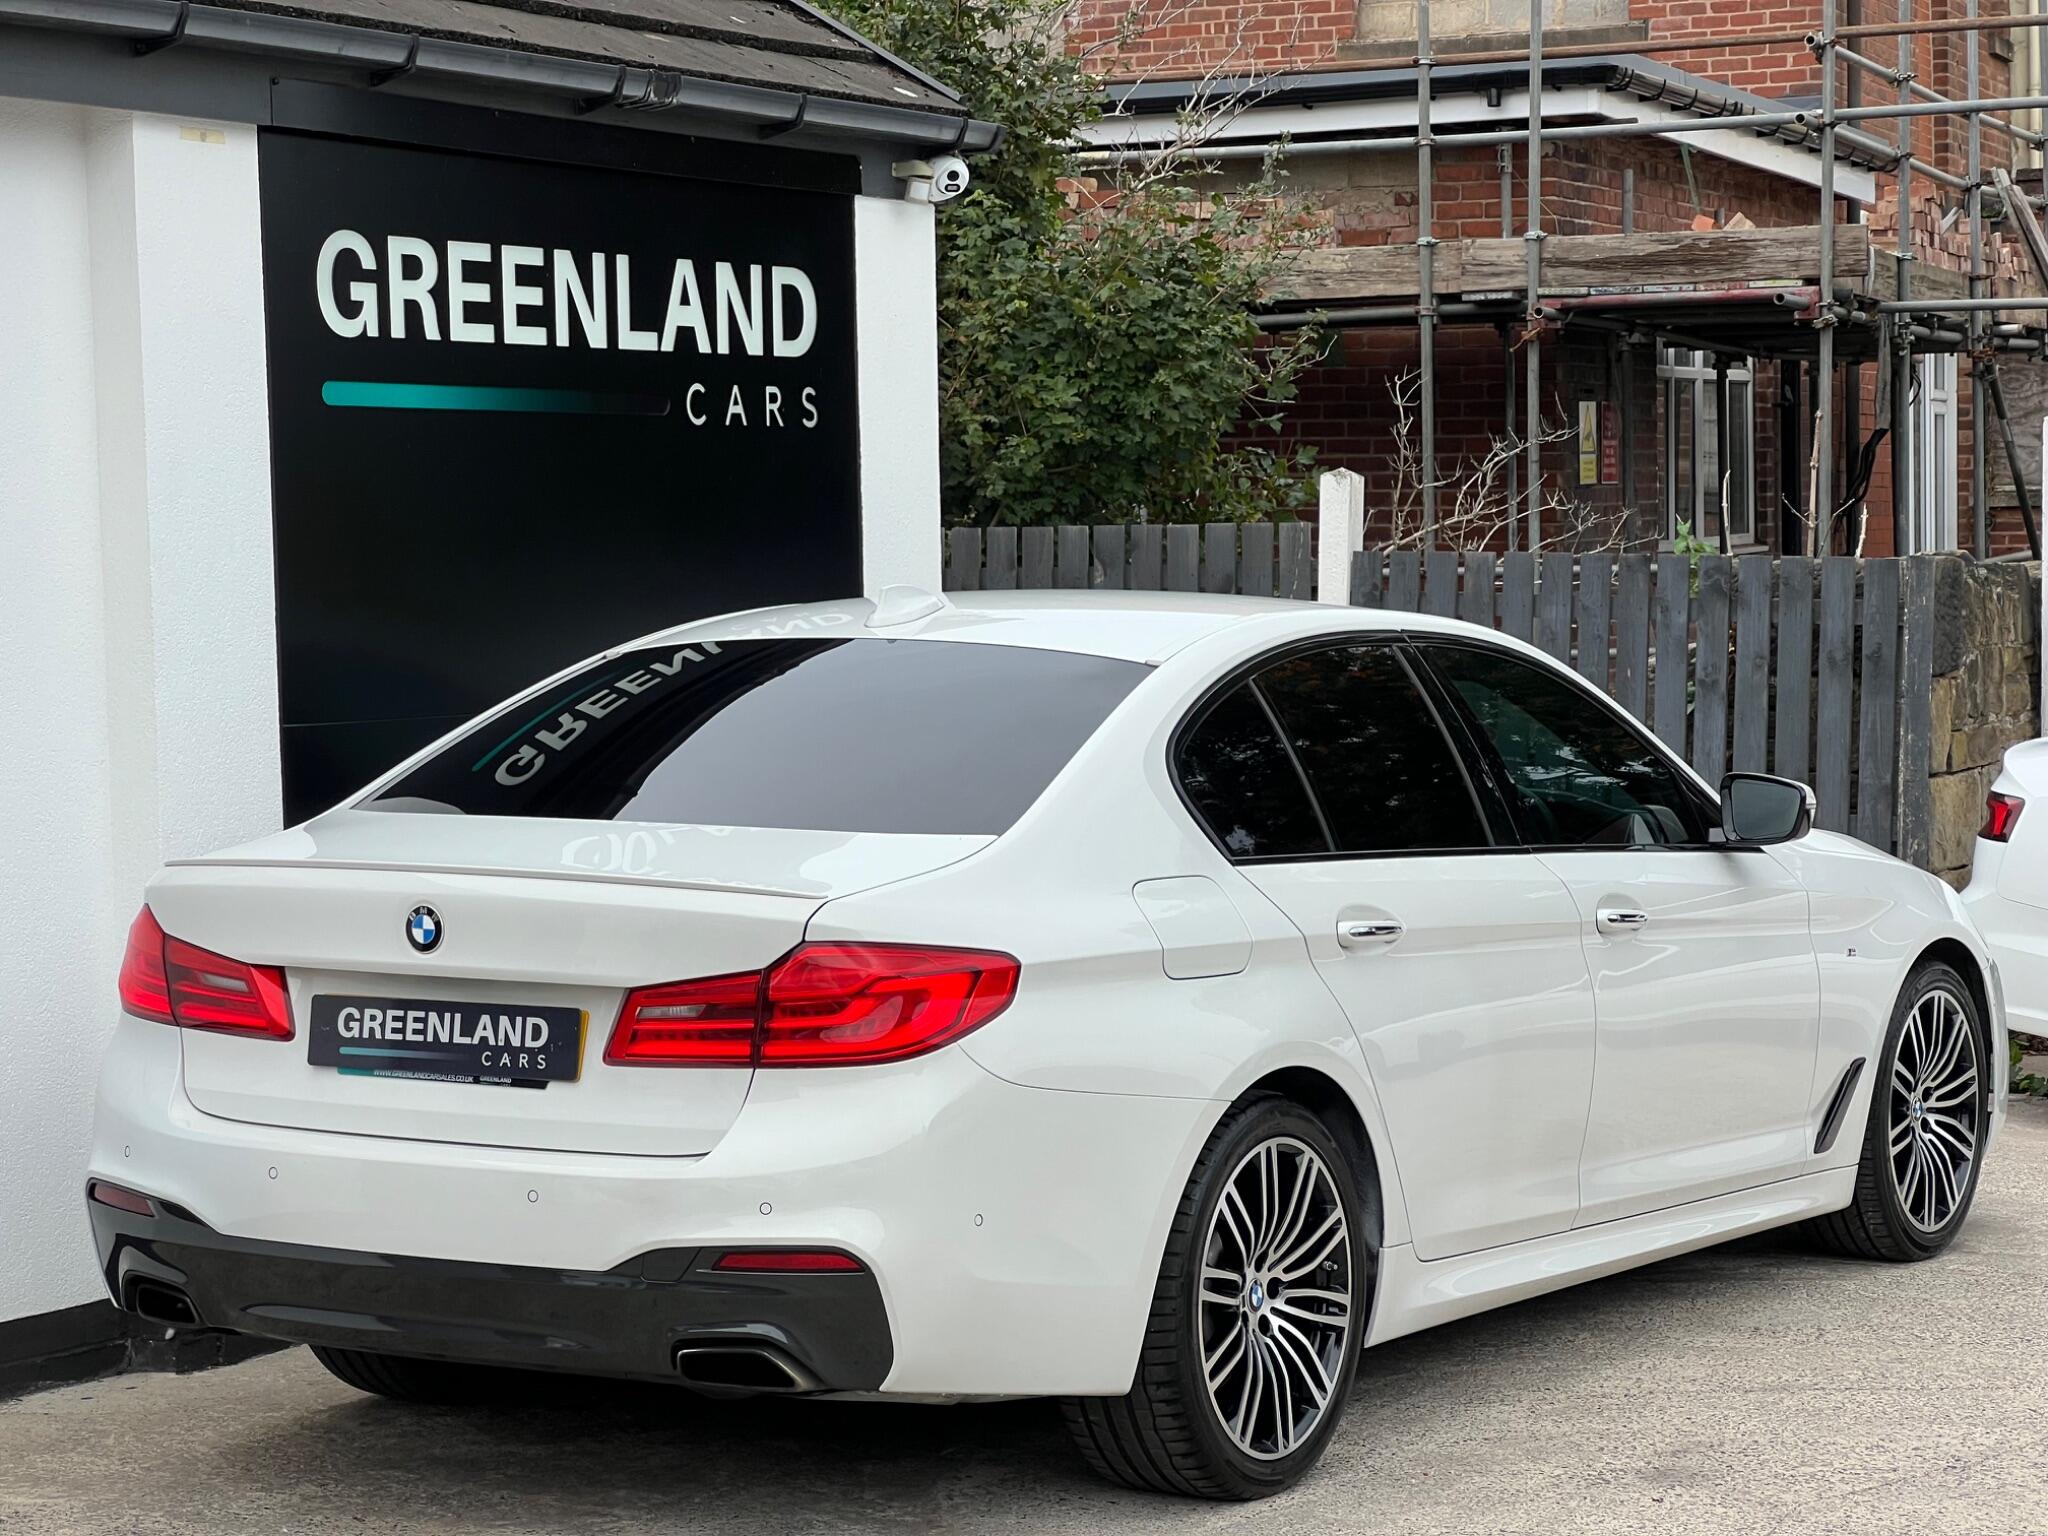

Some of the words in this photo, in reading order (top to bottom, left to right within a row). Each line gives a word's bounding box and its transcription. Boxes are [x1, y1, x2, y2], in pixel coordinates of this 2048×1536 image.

[316, 229, 818, 358] GREENLAND
[685, 382, 818, 429] CARS
[337, 1007, 550, 1049] GREENLAND
[481, 1051, 548, 1070] CARS
